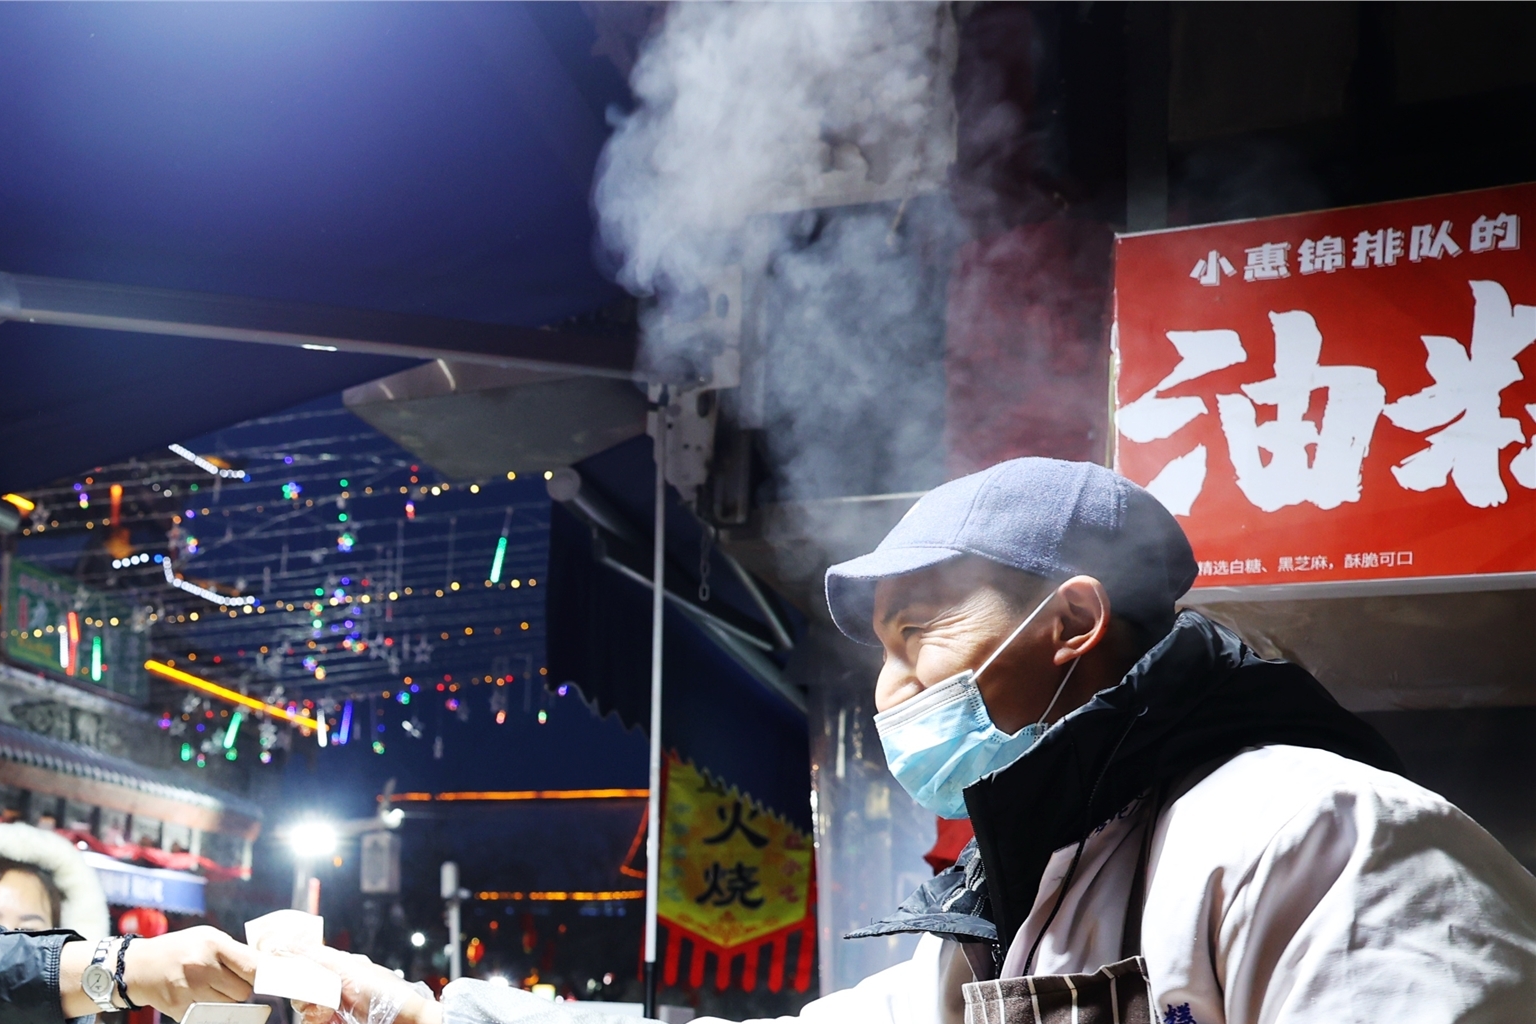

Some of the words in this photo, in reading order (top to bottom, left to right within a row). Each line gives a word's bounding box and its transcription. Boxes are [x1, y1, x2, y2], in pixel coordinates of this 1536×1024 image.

[1189, 212, 1521, 287] 小惠锦排队的
[695, 800, 770, 909] 火烧
